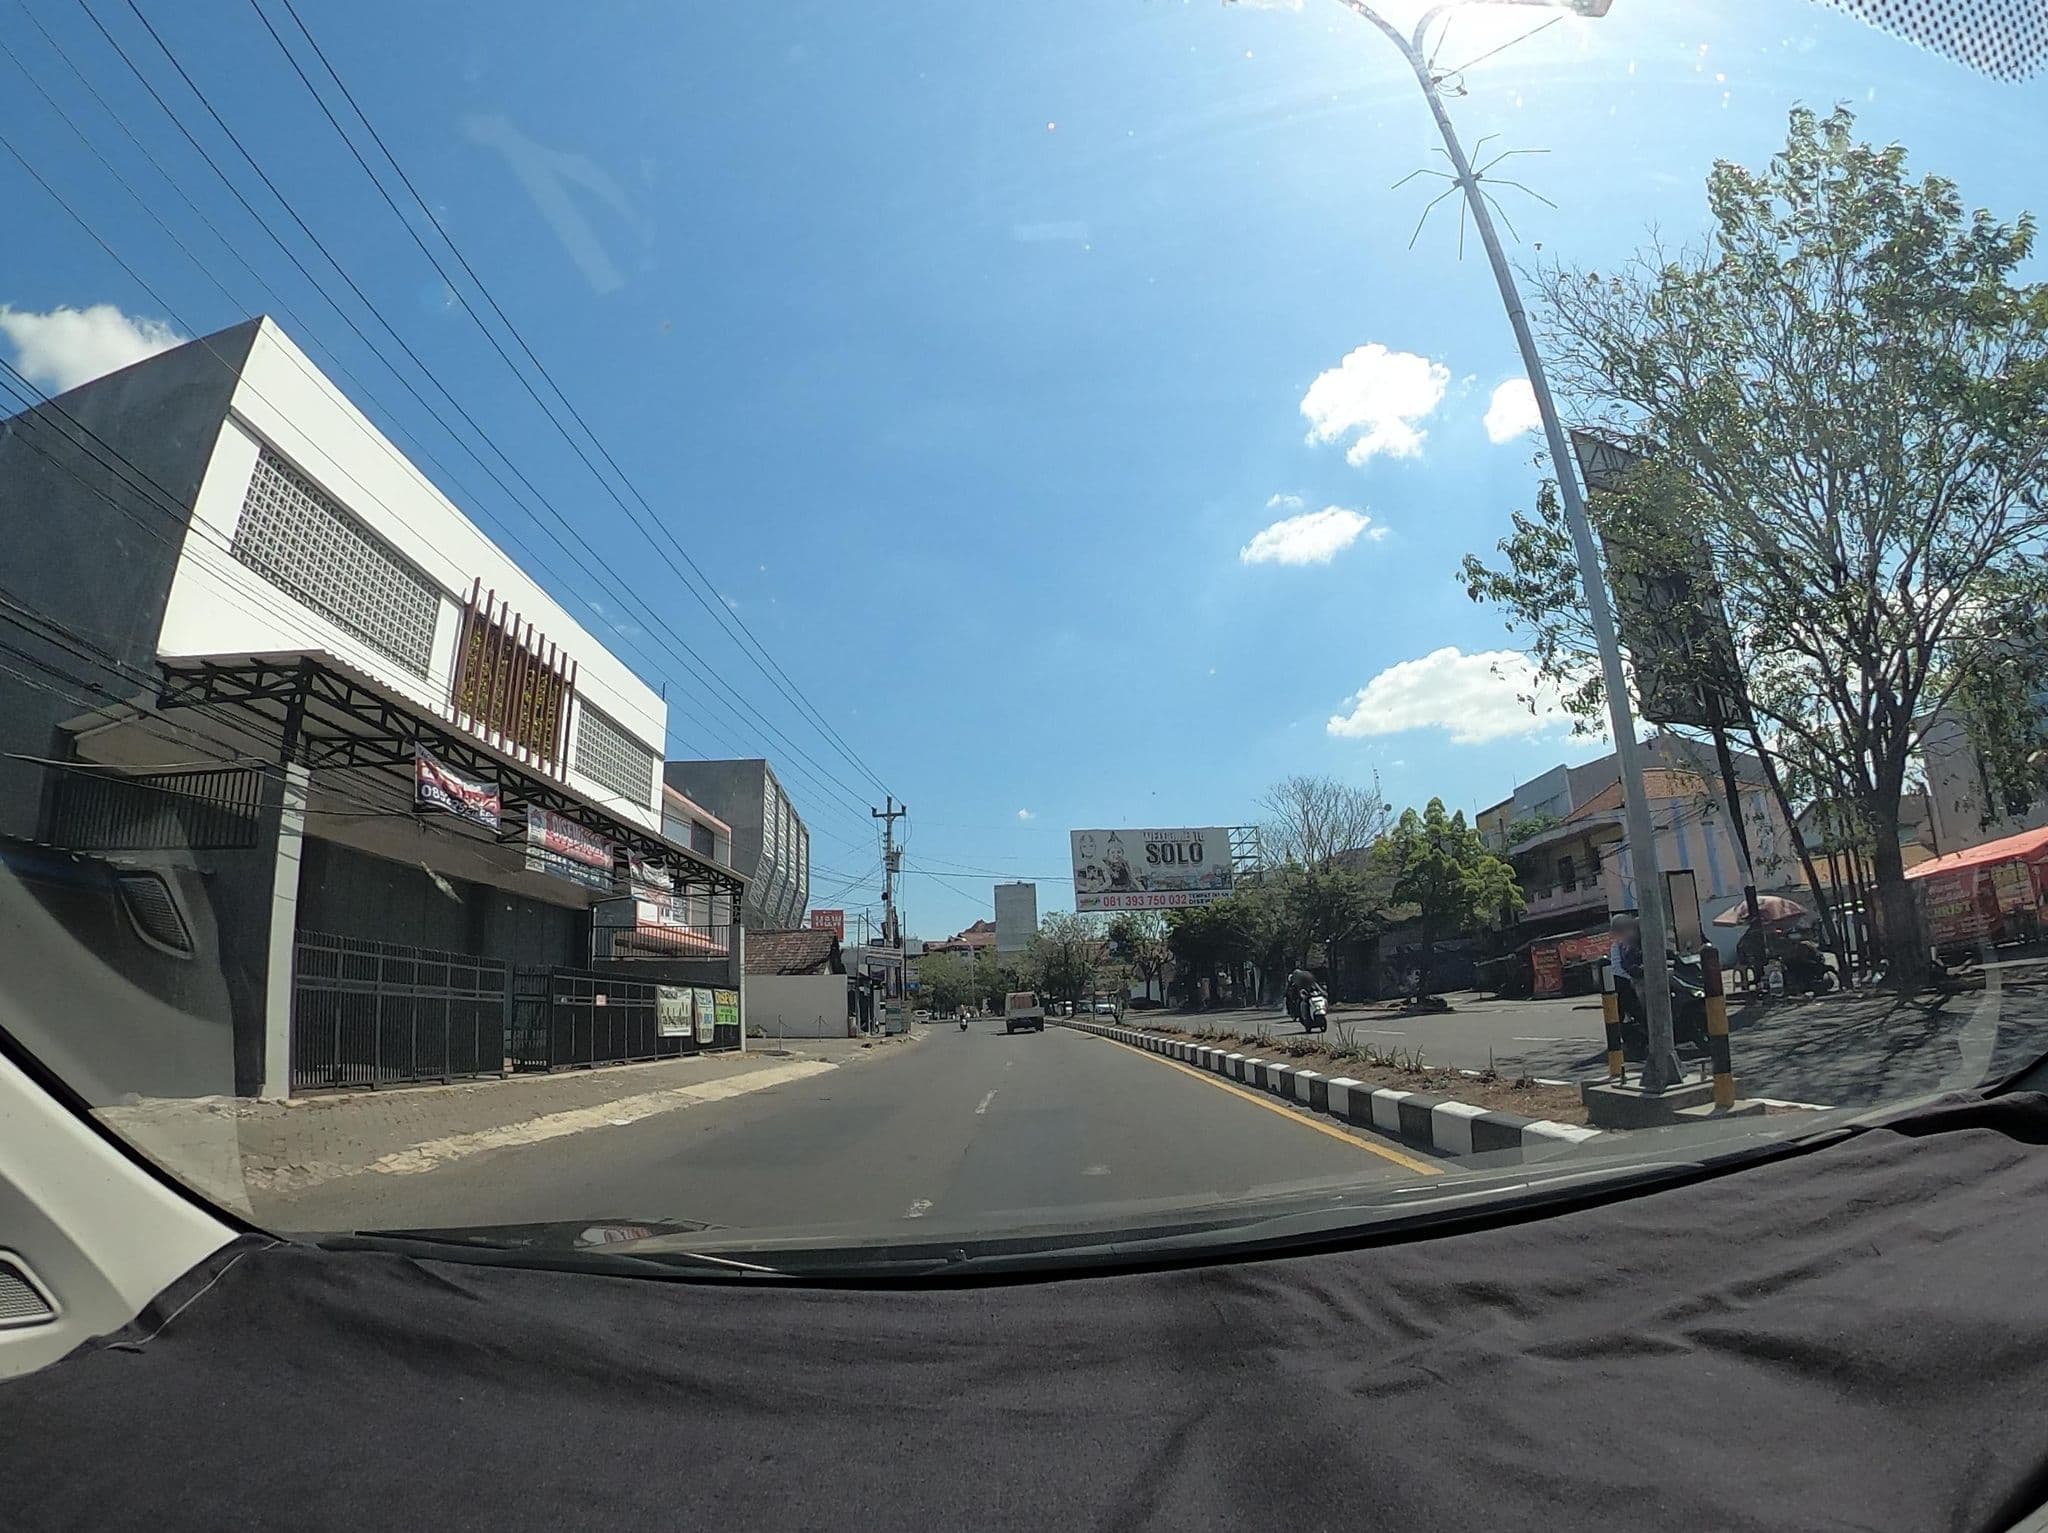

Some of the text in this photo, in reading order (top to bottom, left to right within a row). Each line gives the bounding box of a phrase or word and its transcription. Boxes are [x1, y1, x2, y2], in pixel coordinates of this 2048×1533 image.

[1145, 843, 1205, 865] SOLO
[1103, 896, 1121, 907] 081
[1125, 895, 1145, 907] 393
[1147, 895, 1166, 906] 750
[1168, 894, 1187, 905] 032
